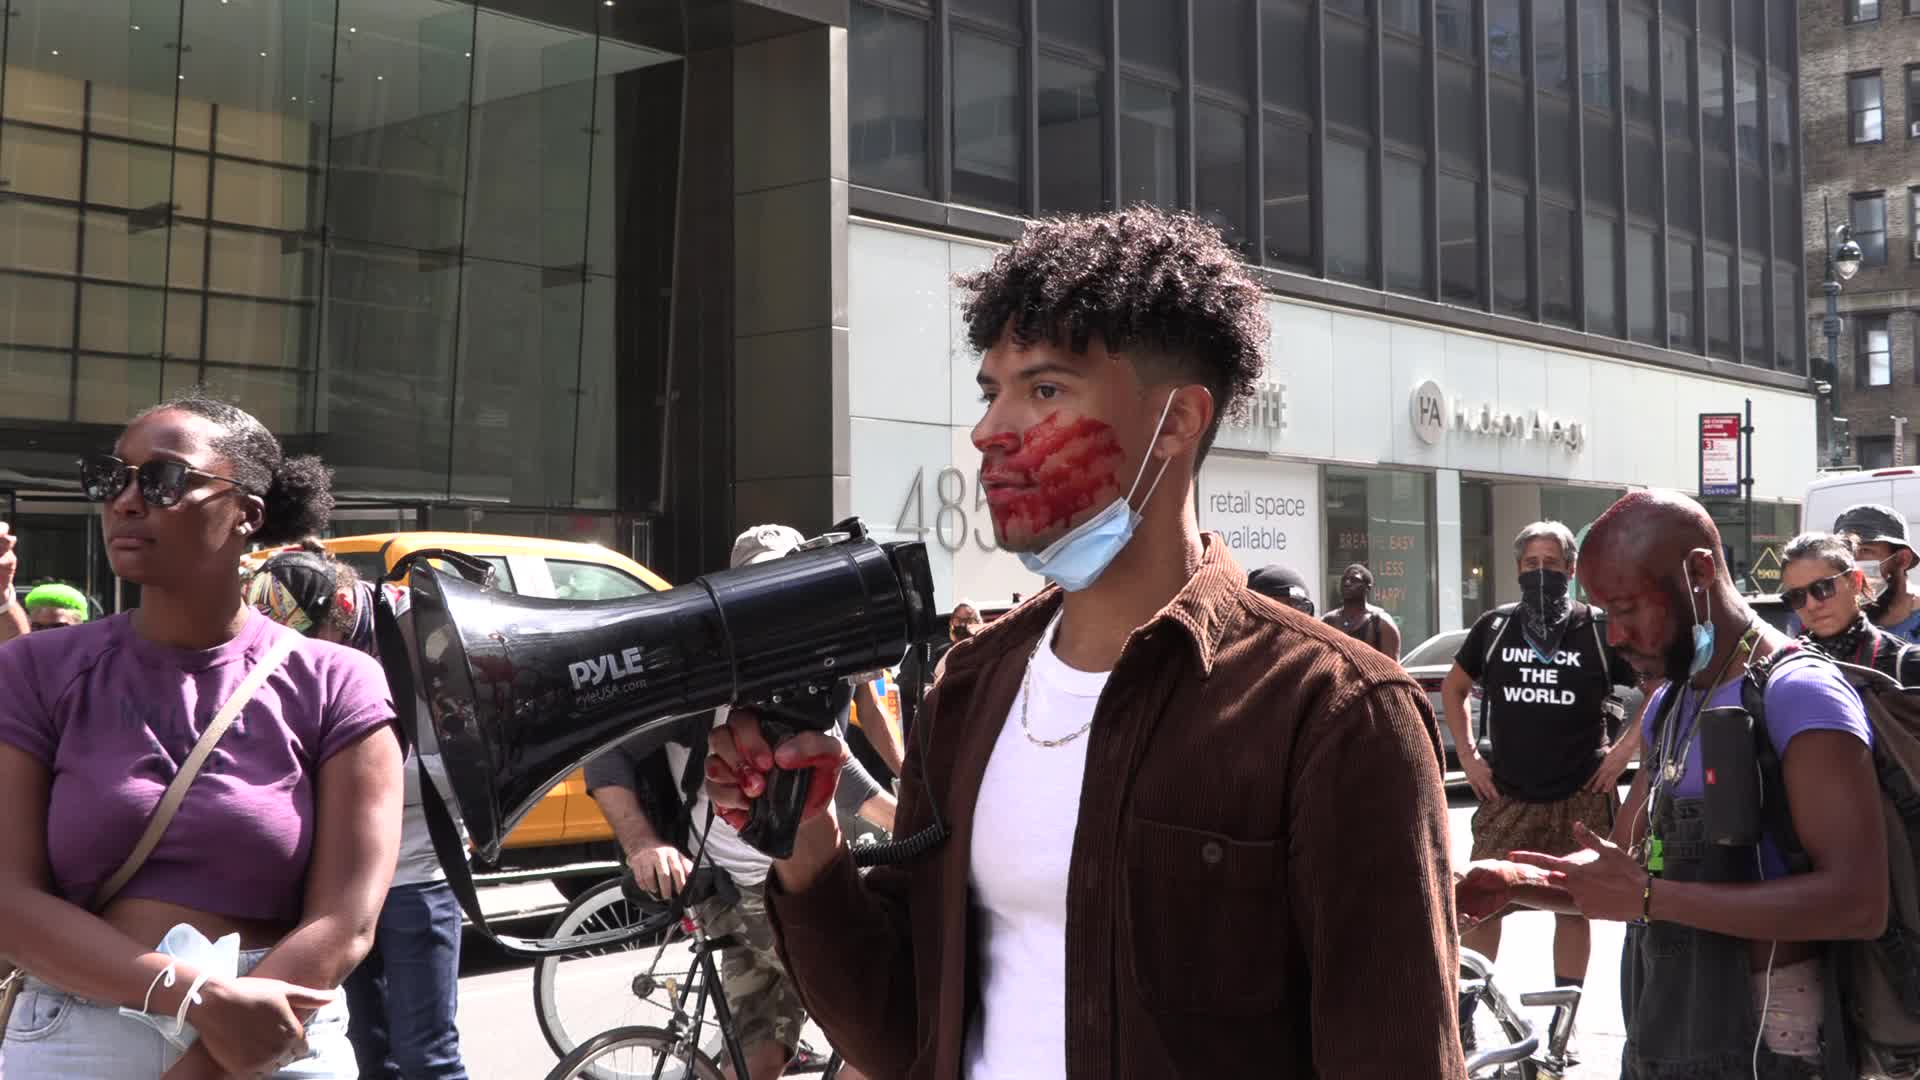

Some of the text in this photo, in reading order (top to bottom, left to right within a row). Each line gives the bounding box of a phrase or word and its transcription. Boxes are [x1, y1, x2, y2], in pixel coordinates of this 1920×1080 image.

[1210, 490, 1305, 520] retail space
[1212, 526, 1287, 551] vailable
[1378, 560, 1405, 577] LESS
[568, 646, 644, 690] PYLE
[1502, 648, 1582, 668] UNFCK
[1519, 667, 1558, 684] THE
[1503, 686, 1576, 705] WORLD
